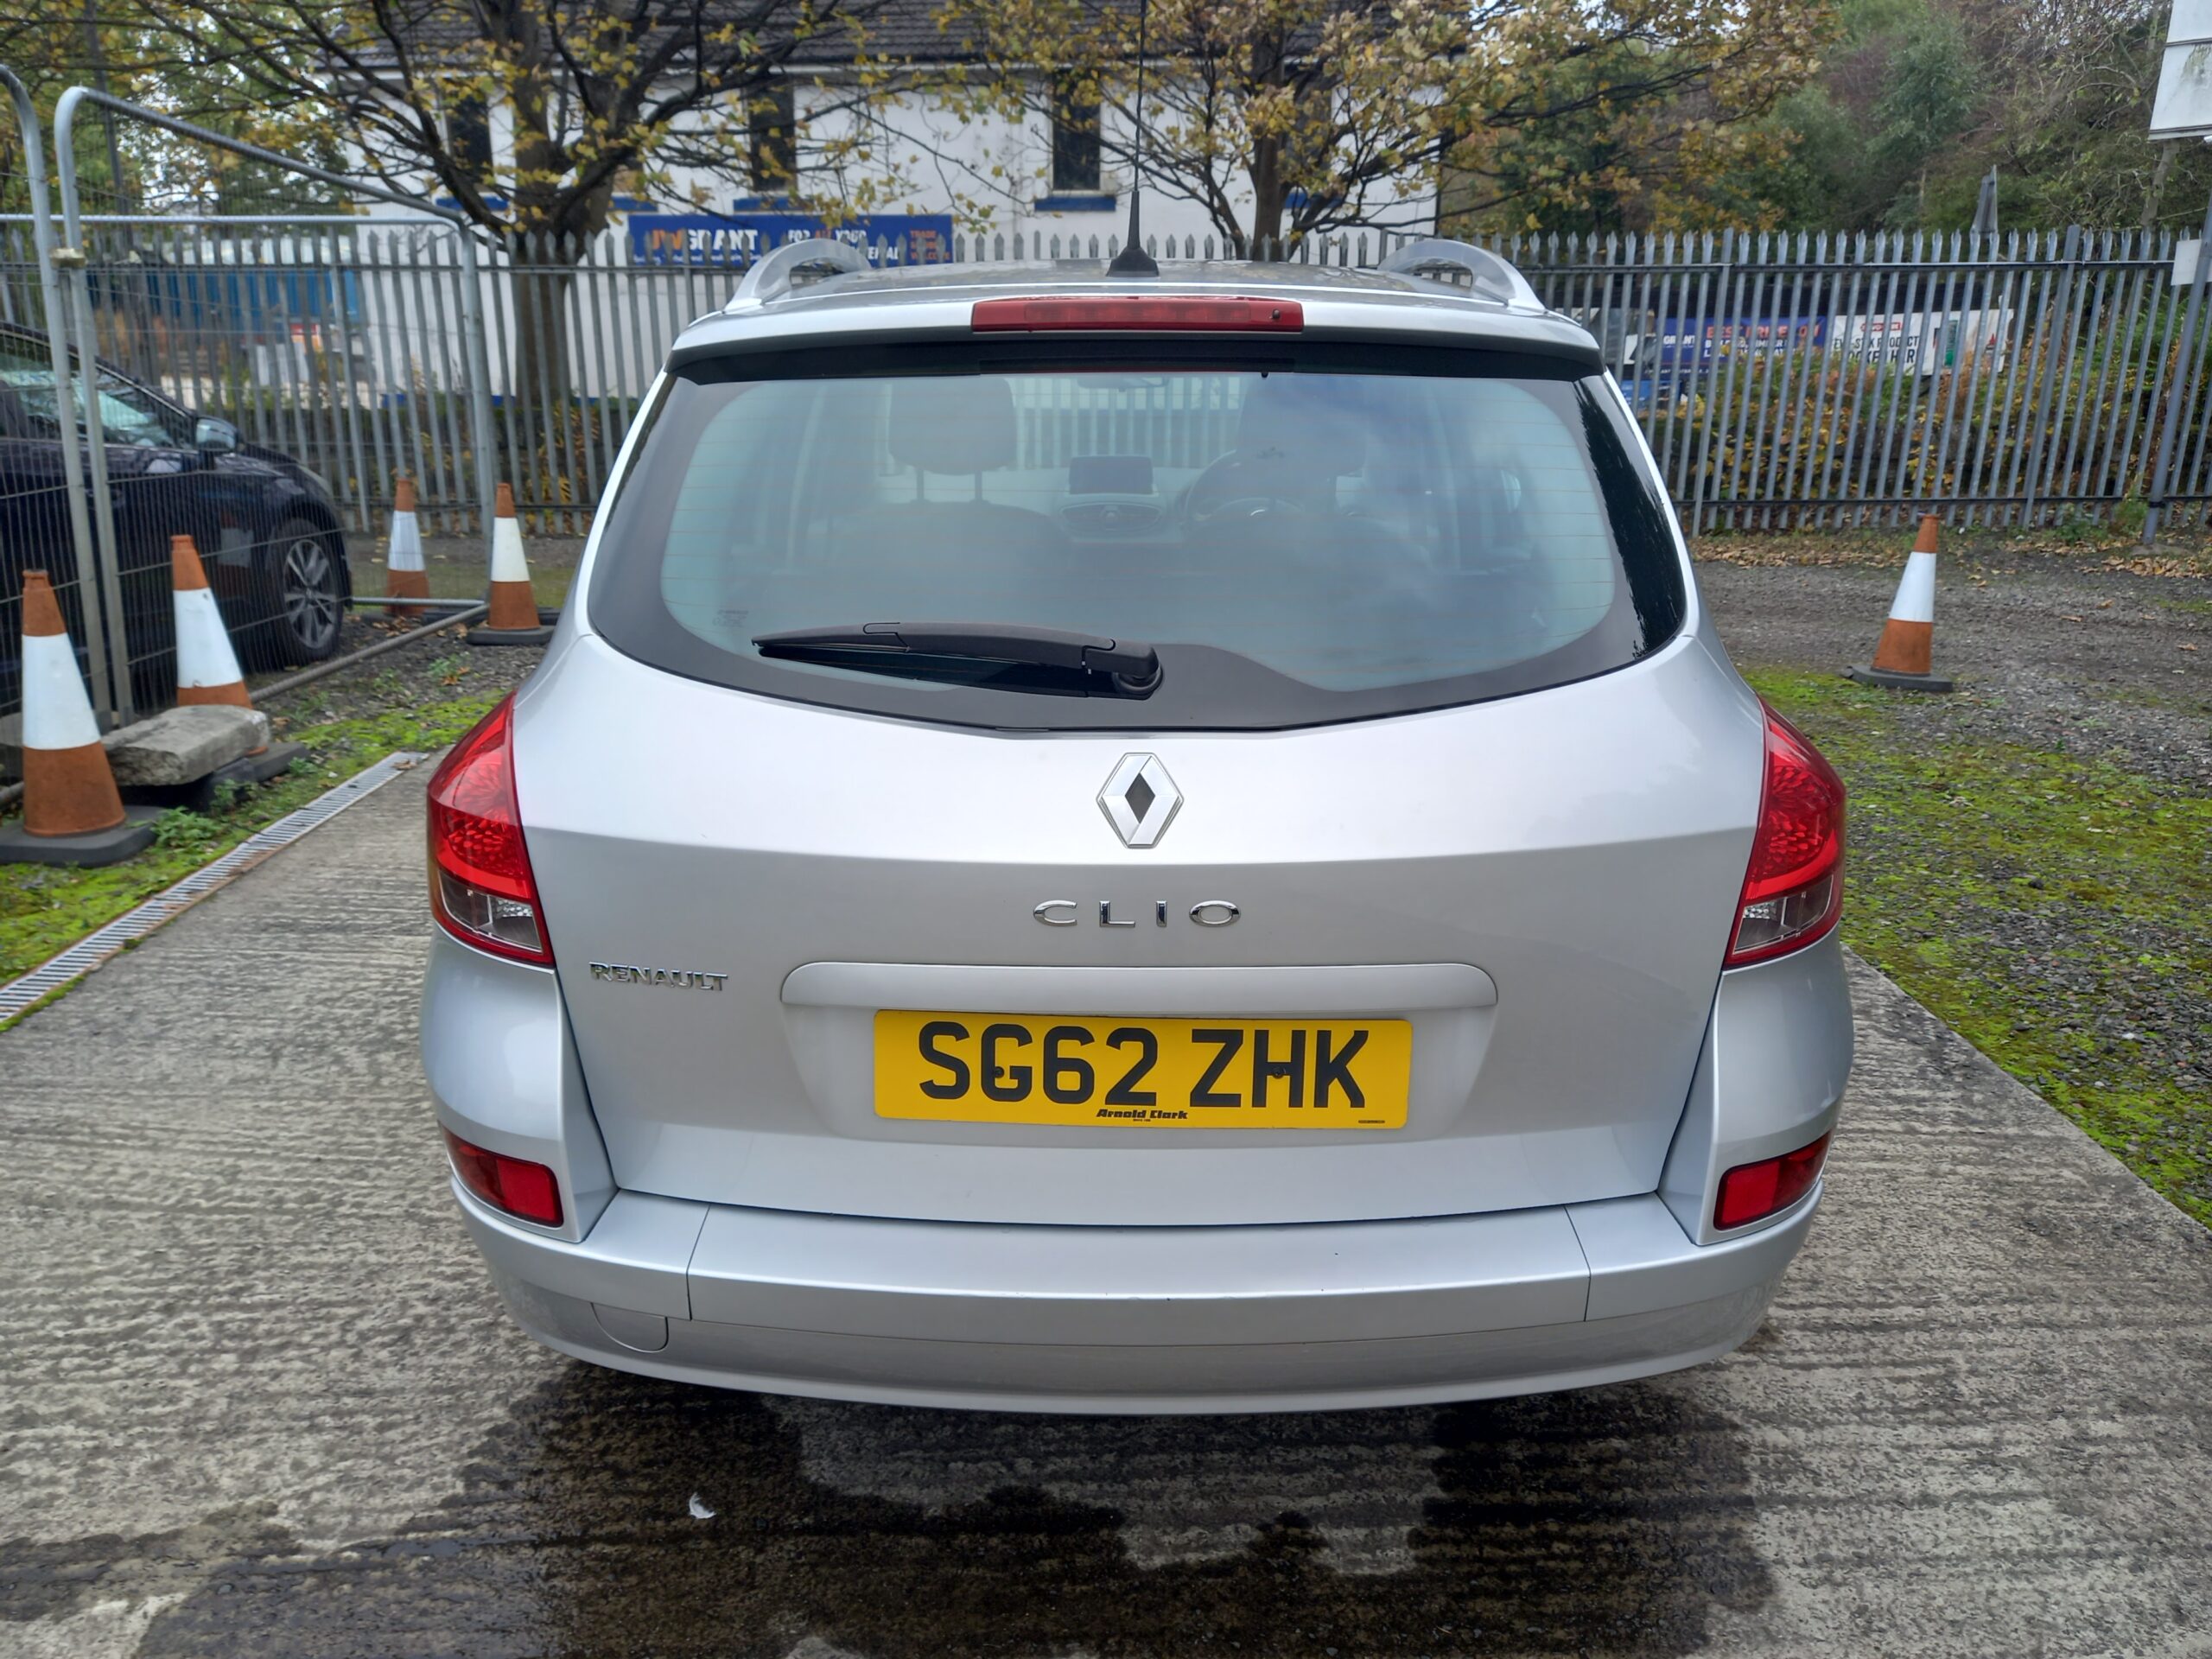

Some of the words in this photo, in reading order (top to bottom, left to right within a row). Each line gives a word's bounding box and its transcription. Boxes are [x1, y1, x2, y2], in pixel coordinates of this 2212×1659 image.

[1033, 899, 1241, 927] CLIO
[588, 961, 728, 992] RENAULT
[918, 1020, 1159, 1107] SG62
[1190, 1028, 1370, 1109] ZHK
[1096, 1109, 1147, 1119] Arnold
[1149, 1109, 1188, 1120] Clark
